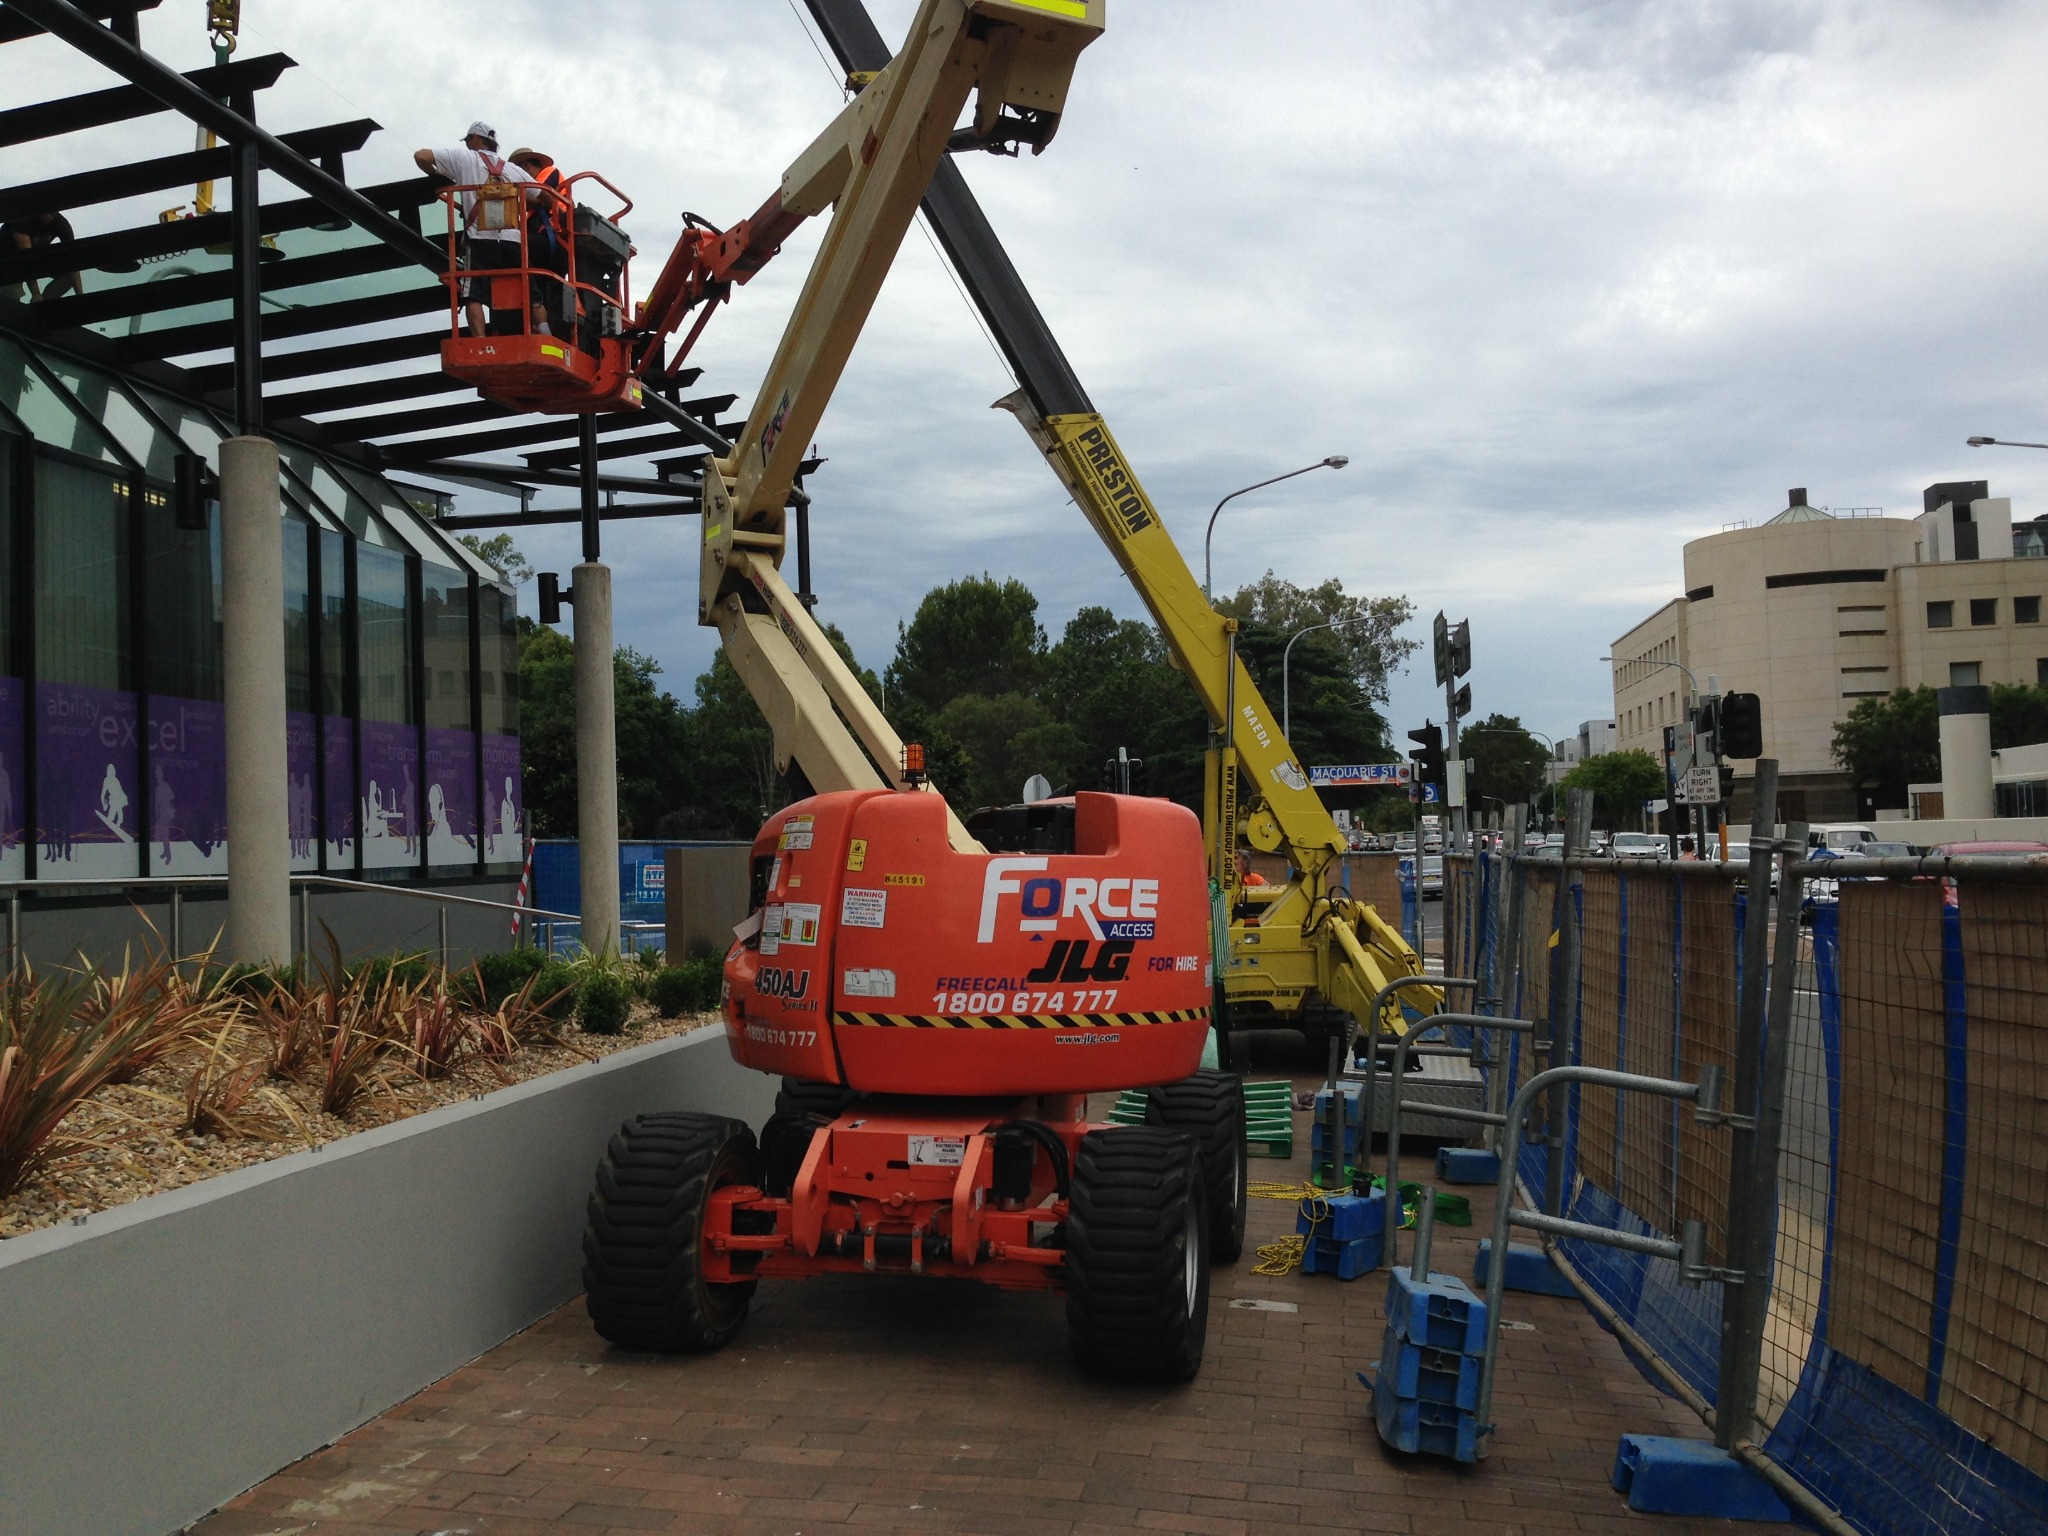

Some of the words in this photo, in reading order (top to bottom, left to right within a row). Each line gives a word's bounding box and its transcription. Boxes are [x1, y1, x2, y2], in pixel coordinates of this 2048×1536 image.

[1078, 427, 1152, 534] PRESTON
[47, 691, 100, 726] ability
[1242, 705, 1271, 749] MAEDA
[1313, 767, 1377, 779] MACQUARIE
[1381, 766, 1395, 777] ST
[1692, 769, 1711, 777] TURN
[1691, 778, 1712, 786] RIGHT
[1224, 765, 1235, 890] WWW.PRESTONGROUP.COM.AU
[885, 876, 923, 885] B45191
[638, 890, 648, 899] 13
[650, 890, 659, 899] 17
[847, 890, 883, 899] WARNING
[977, 857, 1160, 943] FORCE
[1110, 922, 1154, 938] ACCESS
[1026, 940, 1135, 983] JLG
[1148, 957, 1173, 972] FOR
[1175, 955, 1198, 971] HIRE
[754, 966, 811, 1000] 450AJ
[936, 977, 1029, 991] FREECALL
[933, 993, 1005, 1013] 1800
[1011, 991, 1064, 1012] 674
[1072, 989, 1119, 1012] 777
[747, 1025, 766, 1042] 1800
[767, 1029, 786, 1046] 674
[789, 1031, 817, 1047] 777
[1055, 1033, 1120, 1045] www.jlg.com
